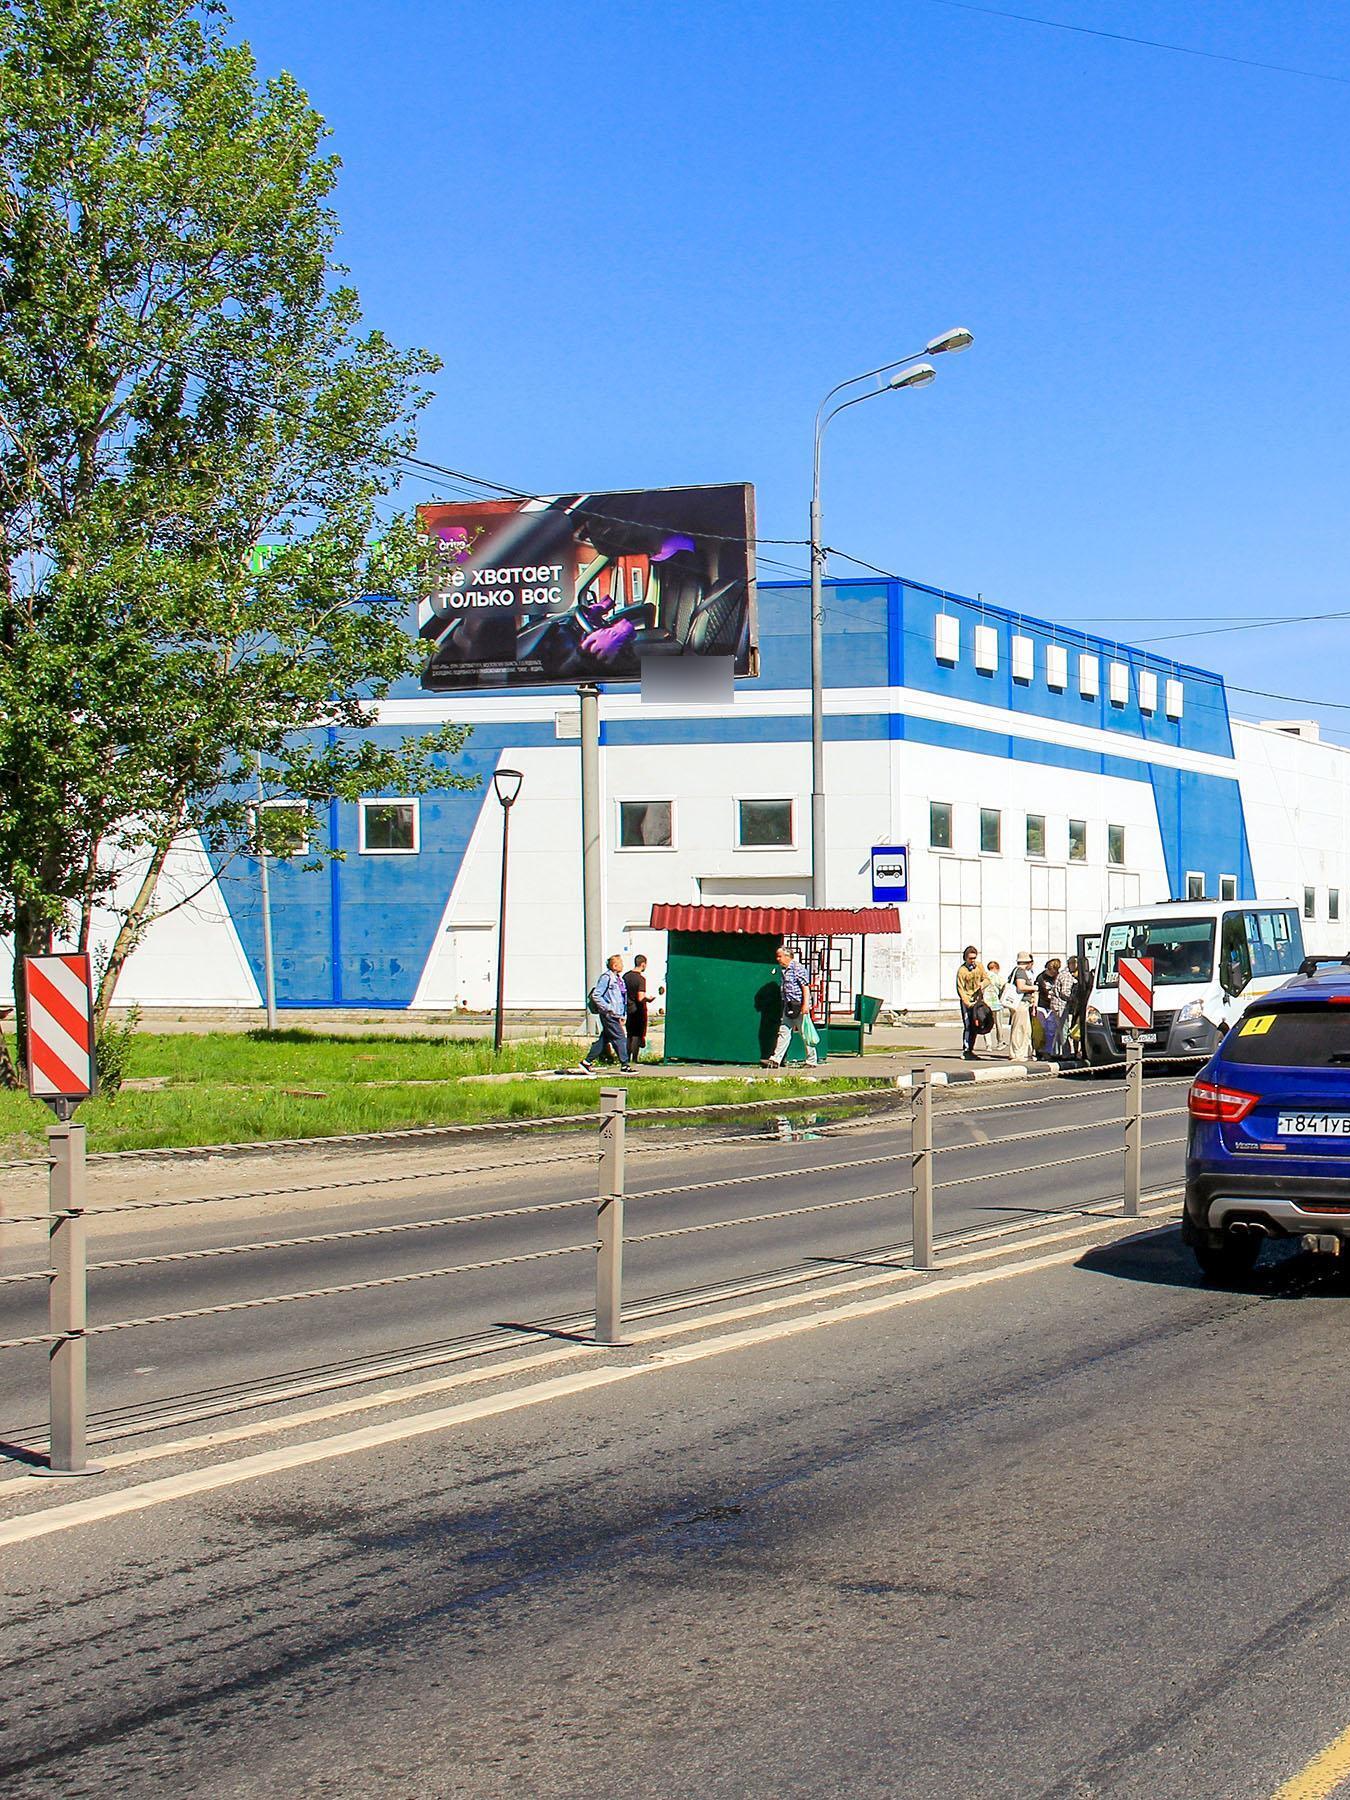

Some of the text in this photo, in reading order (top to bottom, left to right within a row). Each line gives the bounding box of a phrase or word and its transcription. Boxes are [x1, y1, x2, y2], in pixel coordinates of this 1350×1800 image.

[472, 565, 562, 585] хватает
[438, 586, 562, 609] только вас
